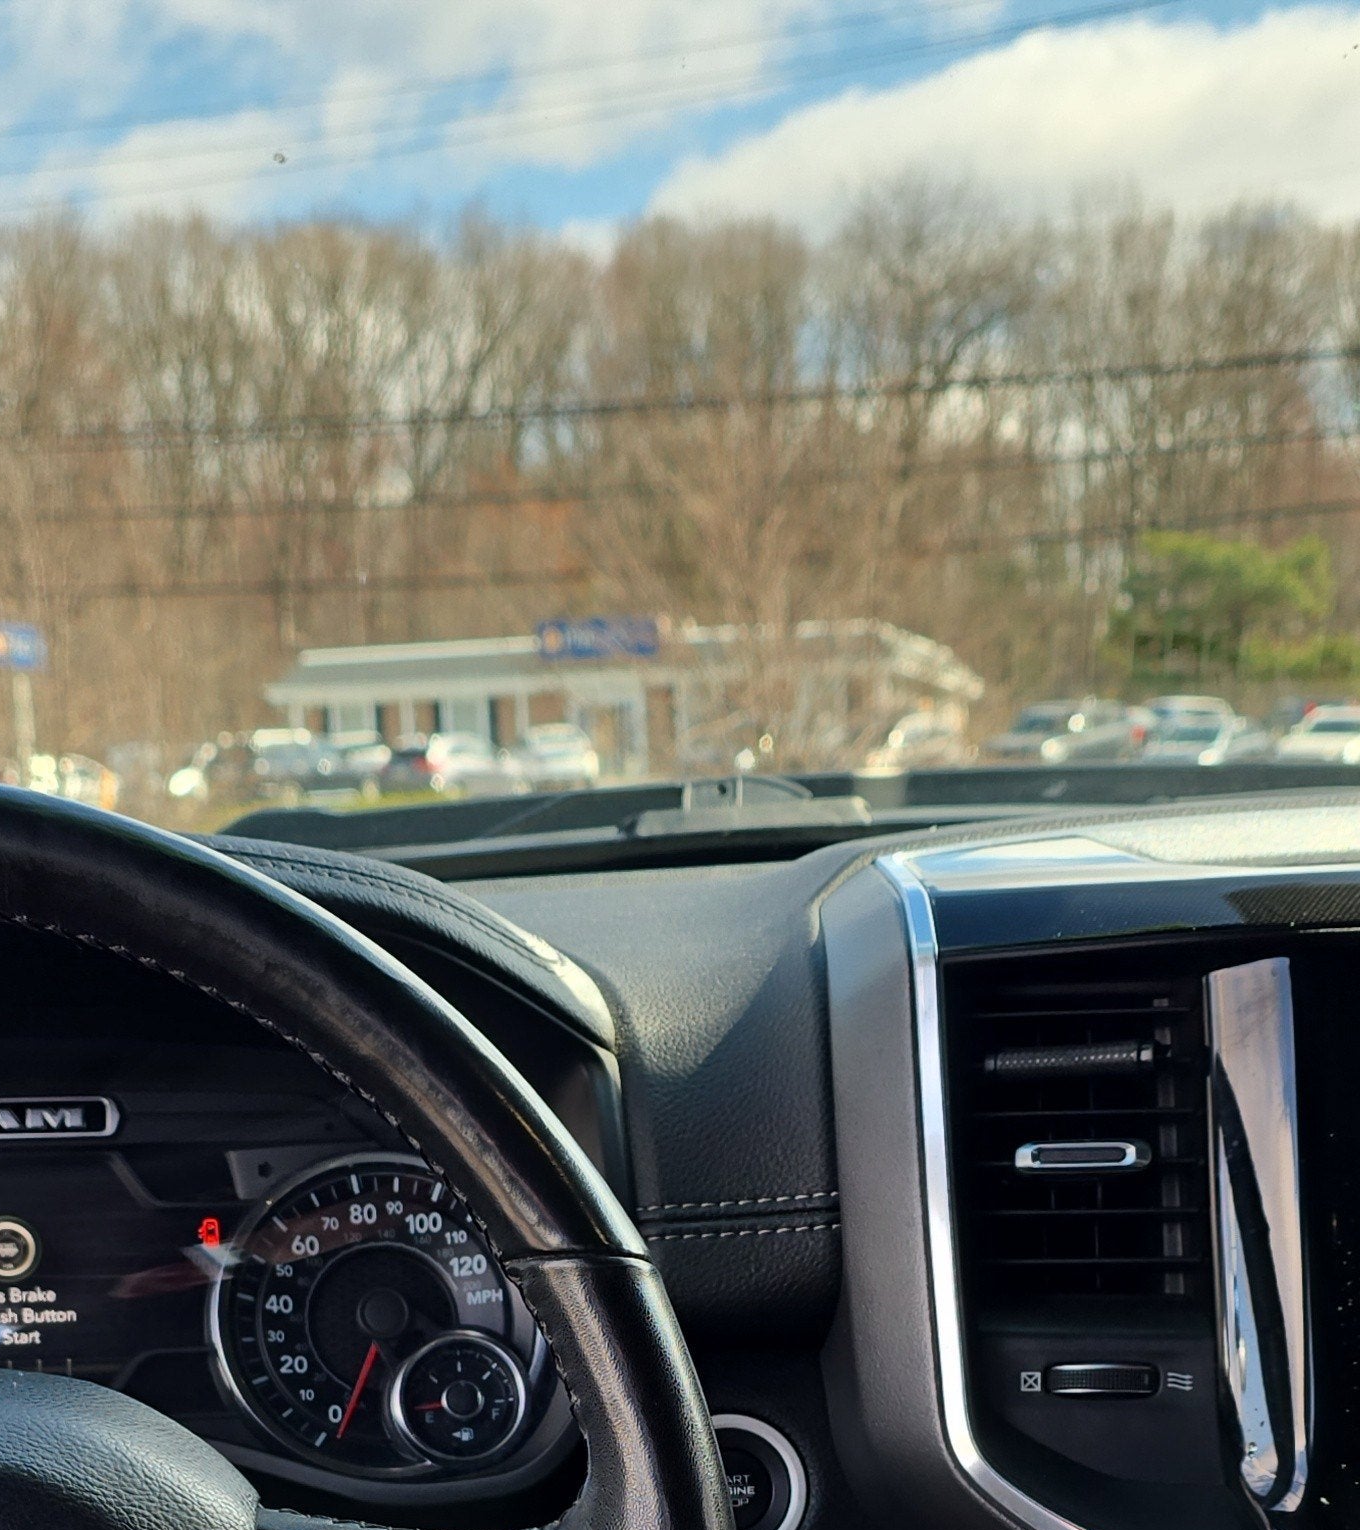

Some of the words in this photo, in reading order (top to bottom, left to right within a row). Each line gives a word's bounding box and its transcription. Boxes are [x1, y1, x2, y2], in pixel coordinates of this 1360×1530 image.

[349, 1202, 377, 1224] 80
[385, 1200, 403, 1215] 90
[321, 1216, 339, 1231] 70
[405, 1211, 442, 1234] 100
[291, 1234, 320, 1256] 60
[444, 1230, 467, 1245] 110
[275, 1264, 293, 1278] 50
[449, 1253, 487, 1277] 120
[8, 1286, 57, 1303] Brake
[466, 1288, 503, 1306] MPH
[265, 1294, 293, 1314] 40
[22, 1307, 77, 1324] Button
[2, 1329, 41, 1345] Start
[267, 1329, 285, 1343] 30
[279, 1354, 308, 1374] 20
[299, 1388, 315, 1401] 10
[328, 1404, 342, 1424] 0
[425, 1411, 434, 1424] E
[491, 1408, 500, 1420] F
